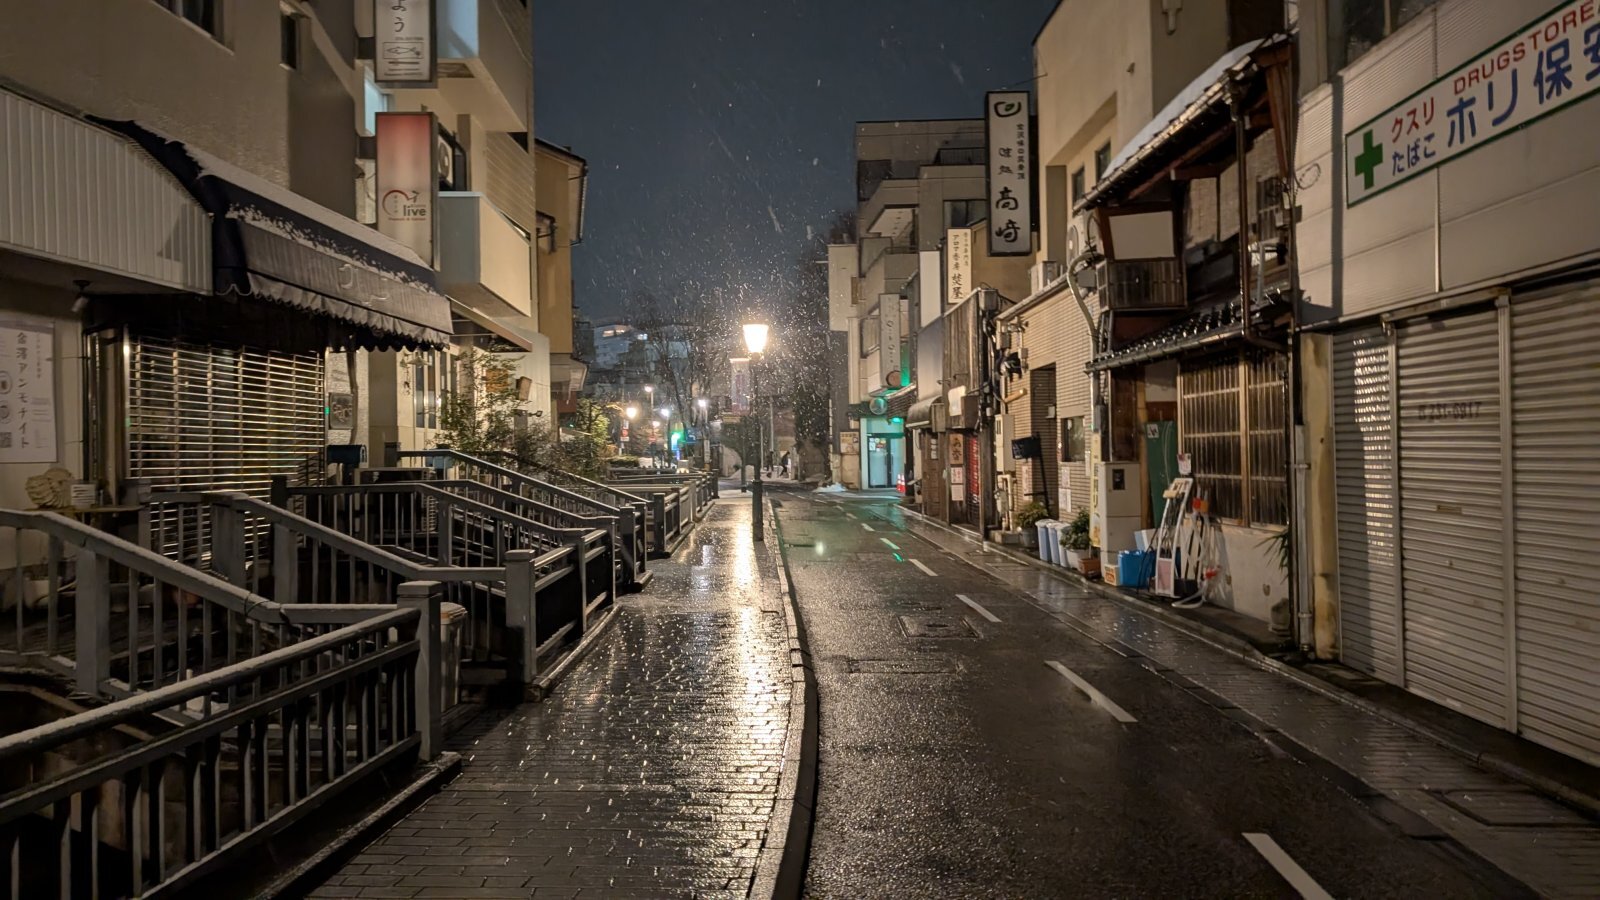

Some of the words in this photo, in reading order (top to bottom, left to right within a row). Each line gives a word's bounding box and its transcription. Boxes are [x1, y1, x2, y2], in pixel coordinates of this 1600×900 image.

[1453, 0, 1595, 96] DRUGSTORE
[1391, 97, 1434, 143] クスリ
[1392, 132, 1436, 176] たばこ
